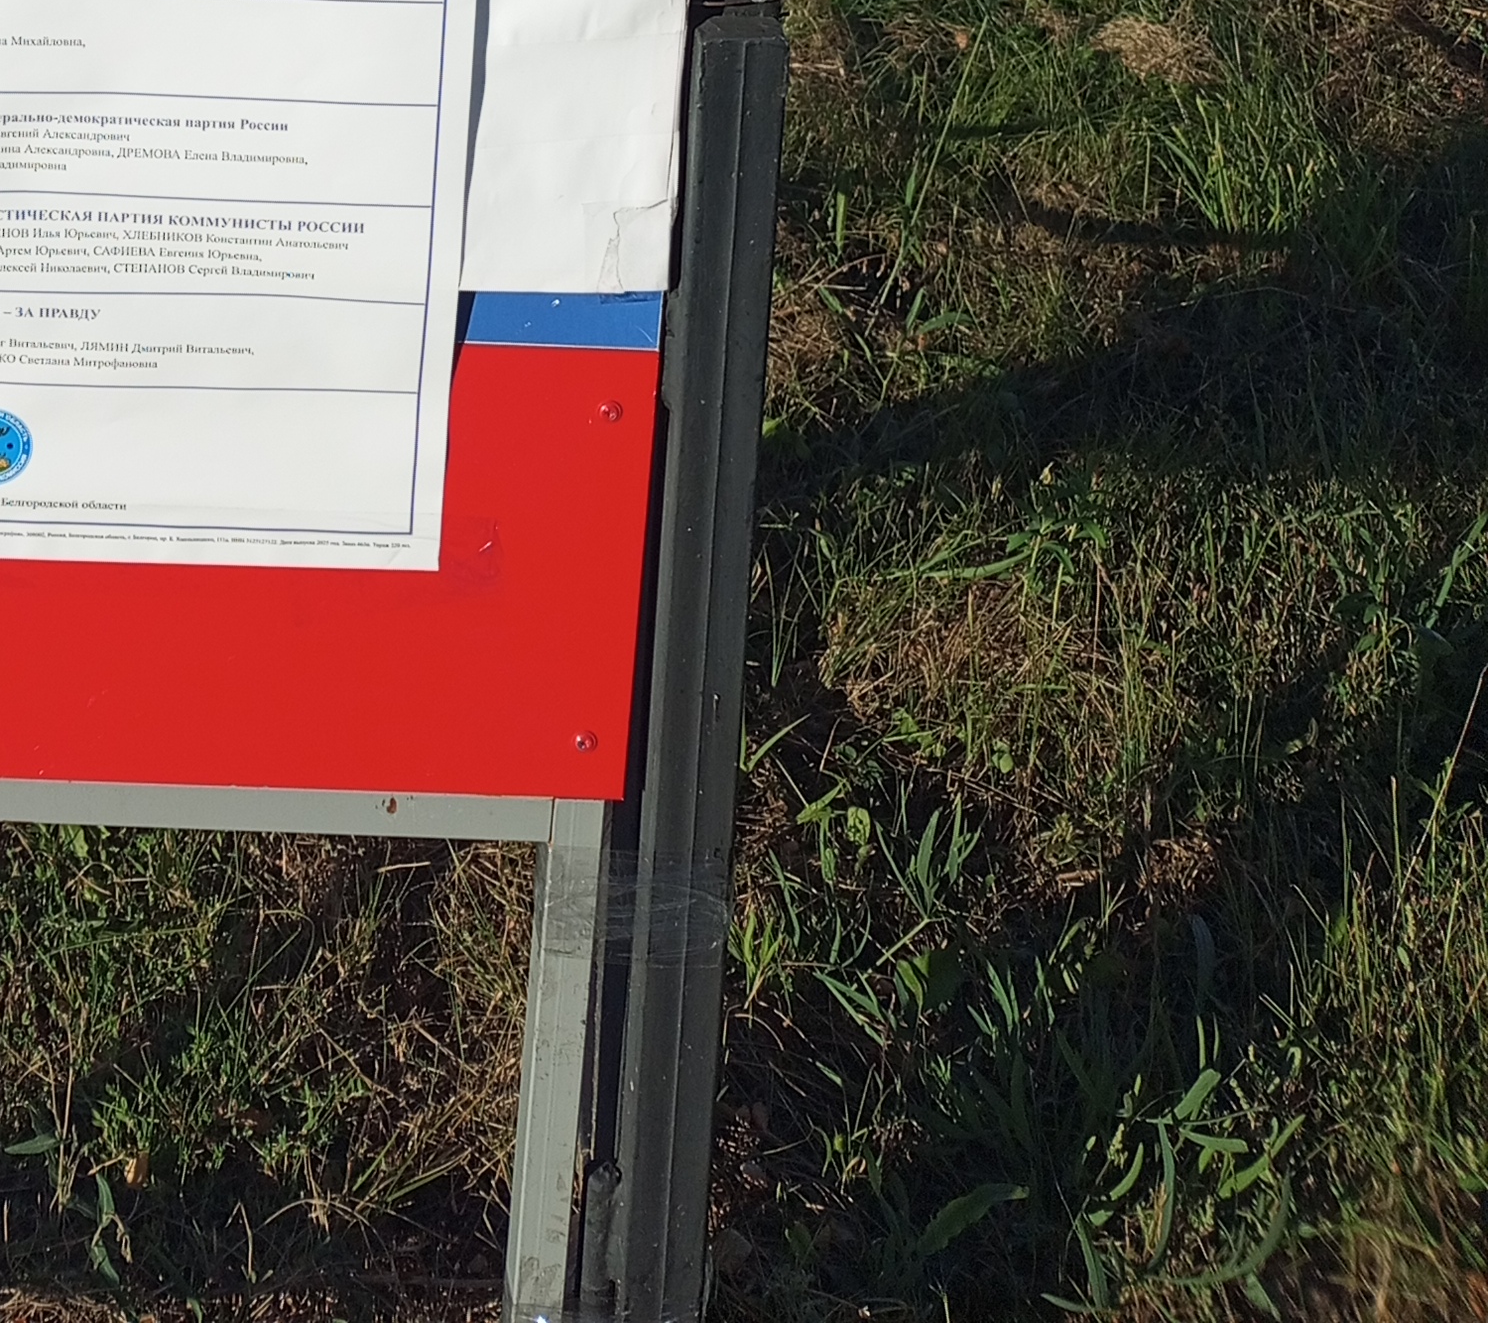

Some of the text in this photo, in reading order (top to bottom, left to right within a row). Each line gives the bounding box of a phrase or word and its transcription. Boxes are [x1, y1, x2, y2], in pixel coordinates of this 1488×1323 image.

[186, 120, 234, 131] партия
[241, 119, 287, 131] России
[98, 212, 162, 224] ПАРТИЯ
[169, 216, 291, 230] КОММУНИСТЫ
[298, 221, 364, 233] РОССИИ
[16, 307, 33, 317] ЗА
[40, 308, 100, 320] ПРАВДУ
[1, 498, 78, 509] Белгородской
[82, 500, 126, 510] области
